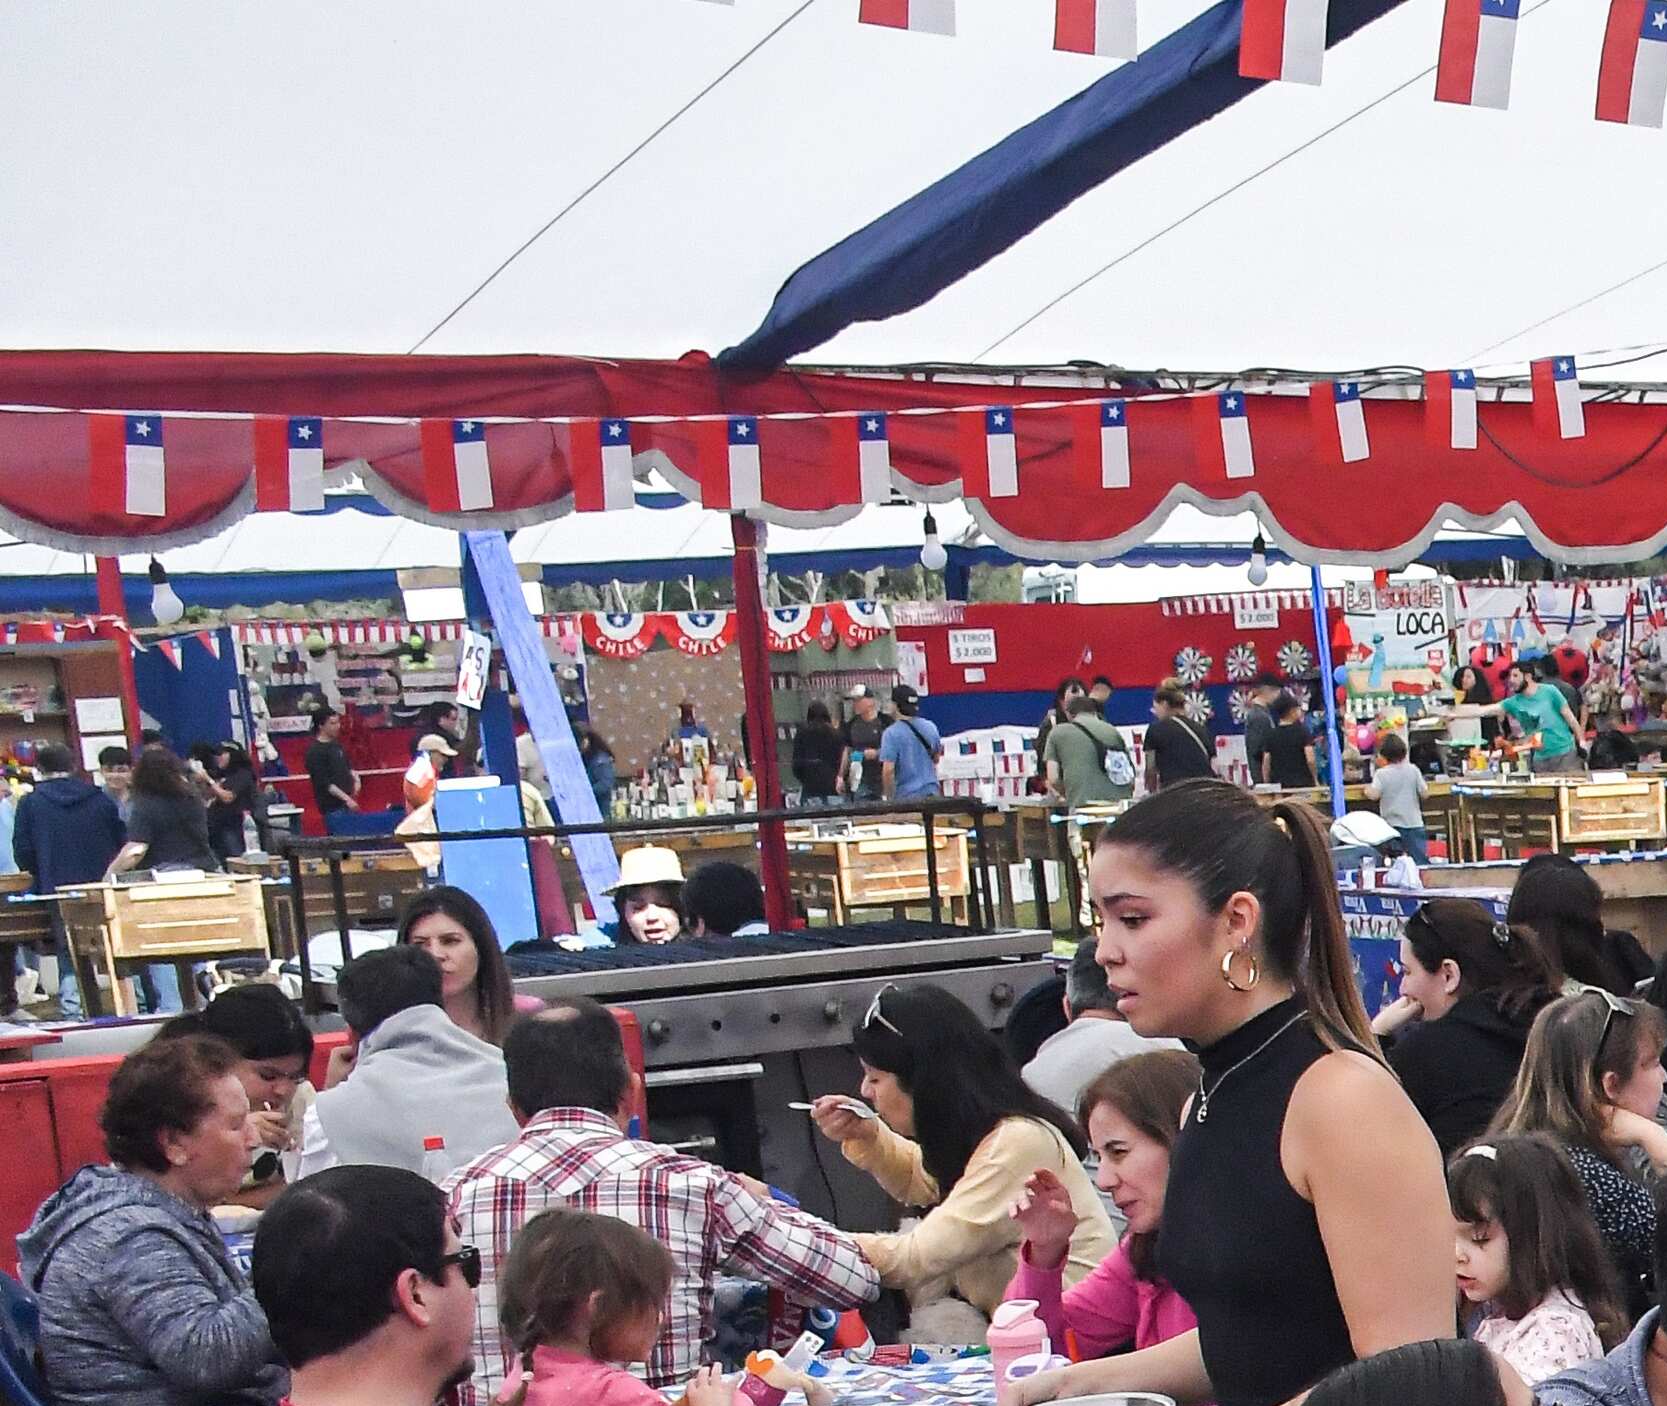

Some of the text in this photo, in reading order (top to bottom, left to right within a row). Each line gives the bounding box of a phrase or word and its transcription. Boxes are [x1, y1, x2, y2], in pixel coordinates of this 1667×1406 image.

[1396, 611, 1445, 636] LOCA
[595, 635, 647, 656] CHILE
[678, 636, 727, 656] CHILE
